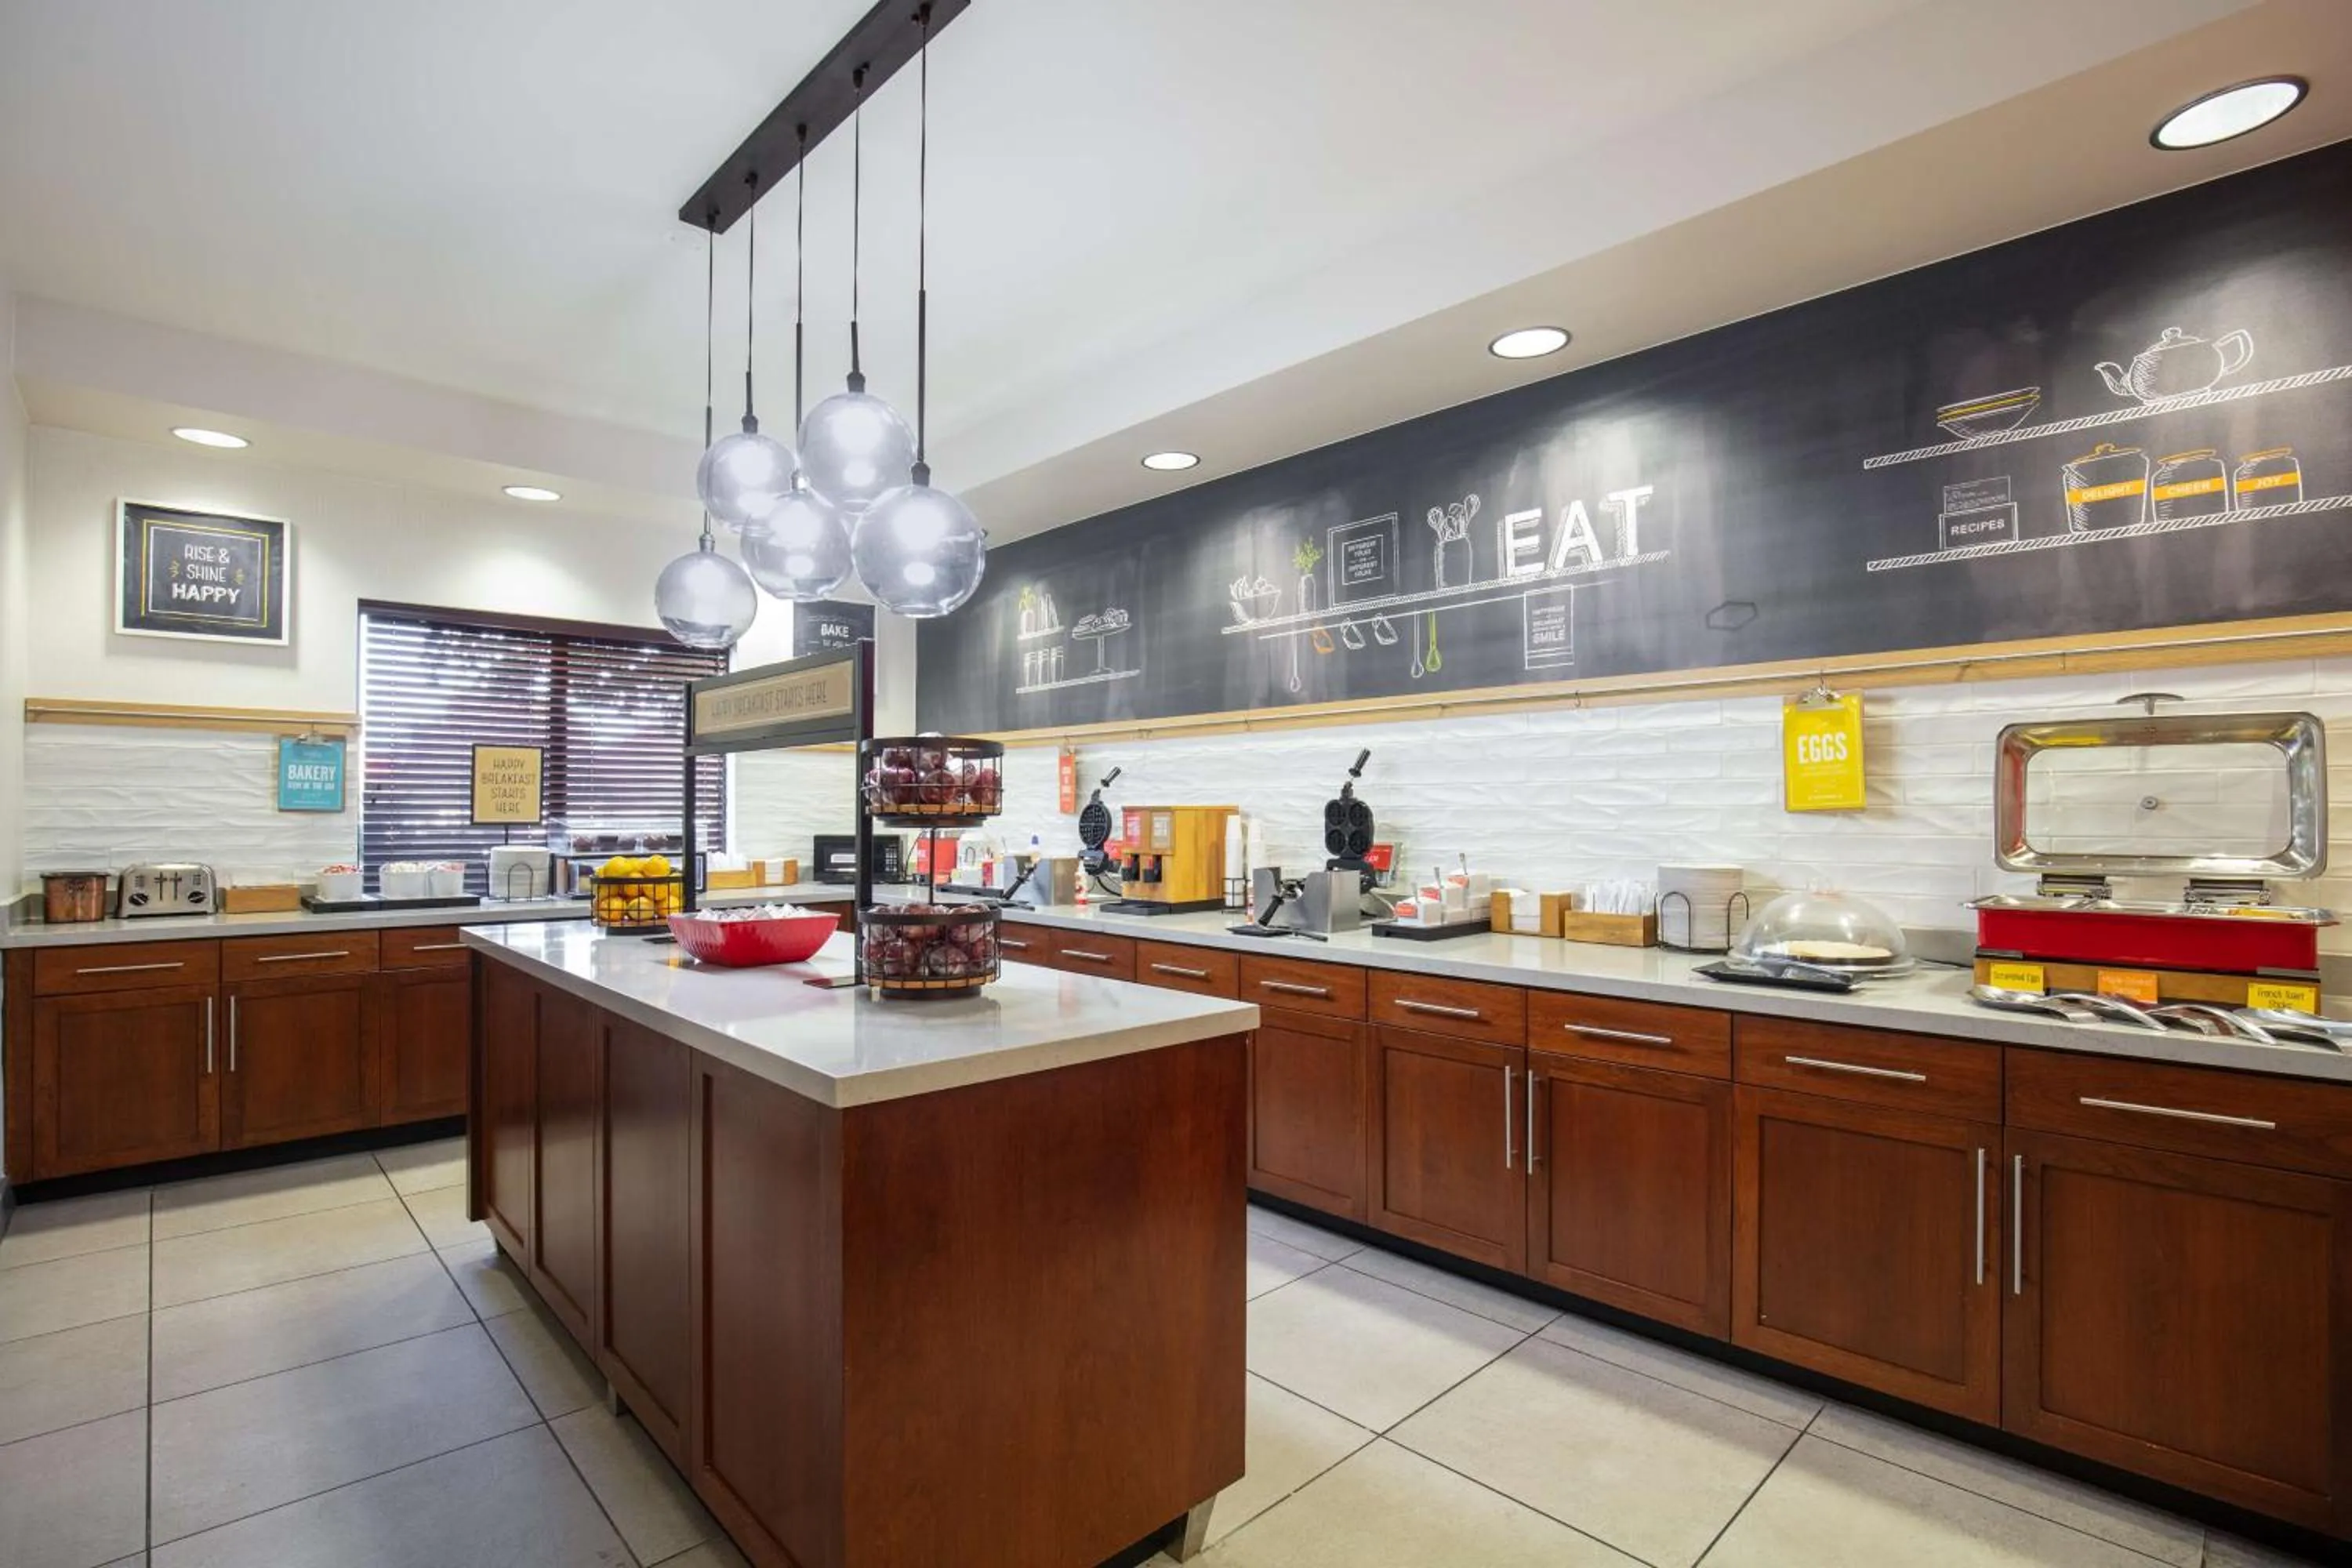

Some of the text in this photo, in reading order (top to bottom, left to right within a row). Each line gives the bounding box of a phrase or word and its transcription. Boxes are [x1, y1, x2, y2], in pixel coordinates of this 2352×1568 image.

[2167, 479, 2210, 495] CHEER
[2255, 474, 2283, 489] JOY
[2082, 484, 2133, 500] DELIGHT
[1497, 485, 1654, 579] EAT
[1951, 518, 2005, 536] RECIPES
[184, 543, 230, 564] RISE &
[186, 564, 227, 583] SHINE
[172, 583, 241, 605] HAPPY
[821, 623, 850, 638] BAKE
[1533, 630, 1566, 644] SMILE
[775, 684, 804, 713] STARTS
[805, 679, 827, 706] HERE
[1798, 731, 1848, 764] EGGS
[492, 757, 526, 770] HAPPY
[287, 764, 336, 782] BAKERY
[481, 771, 536, 786] BREAKFAST
[491, 786, 527, 800] STARTS
[495, 800, 521, 815] HERE
